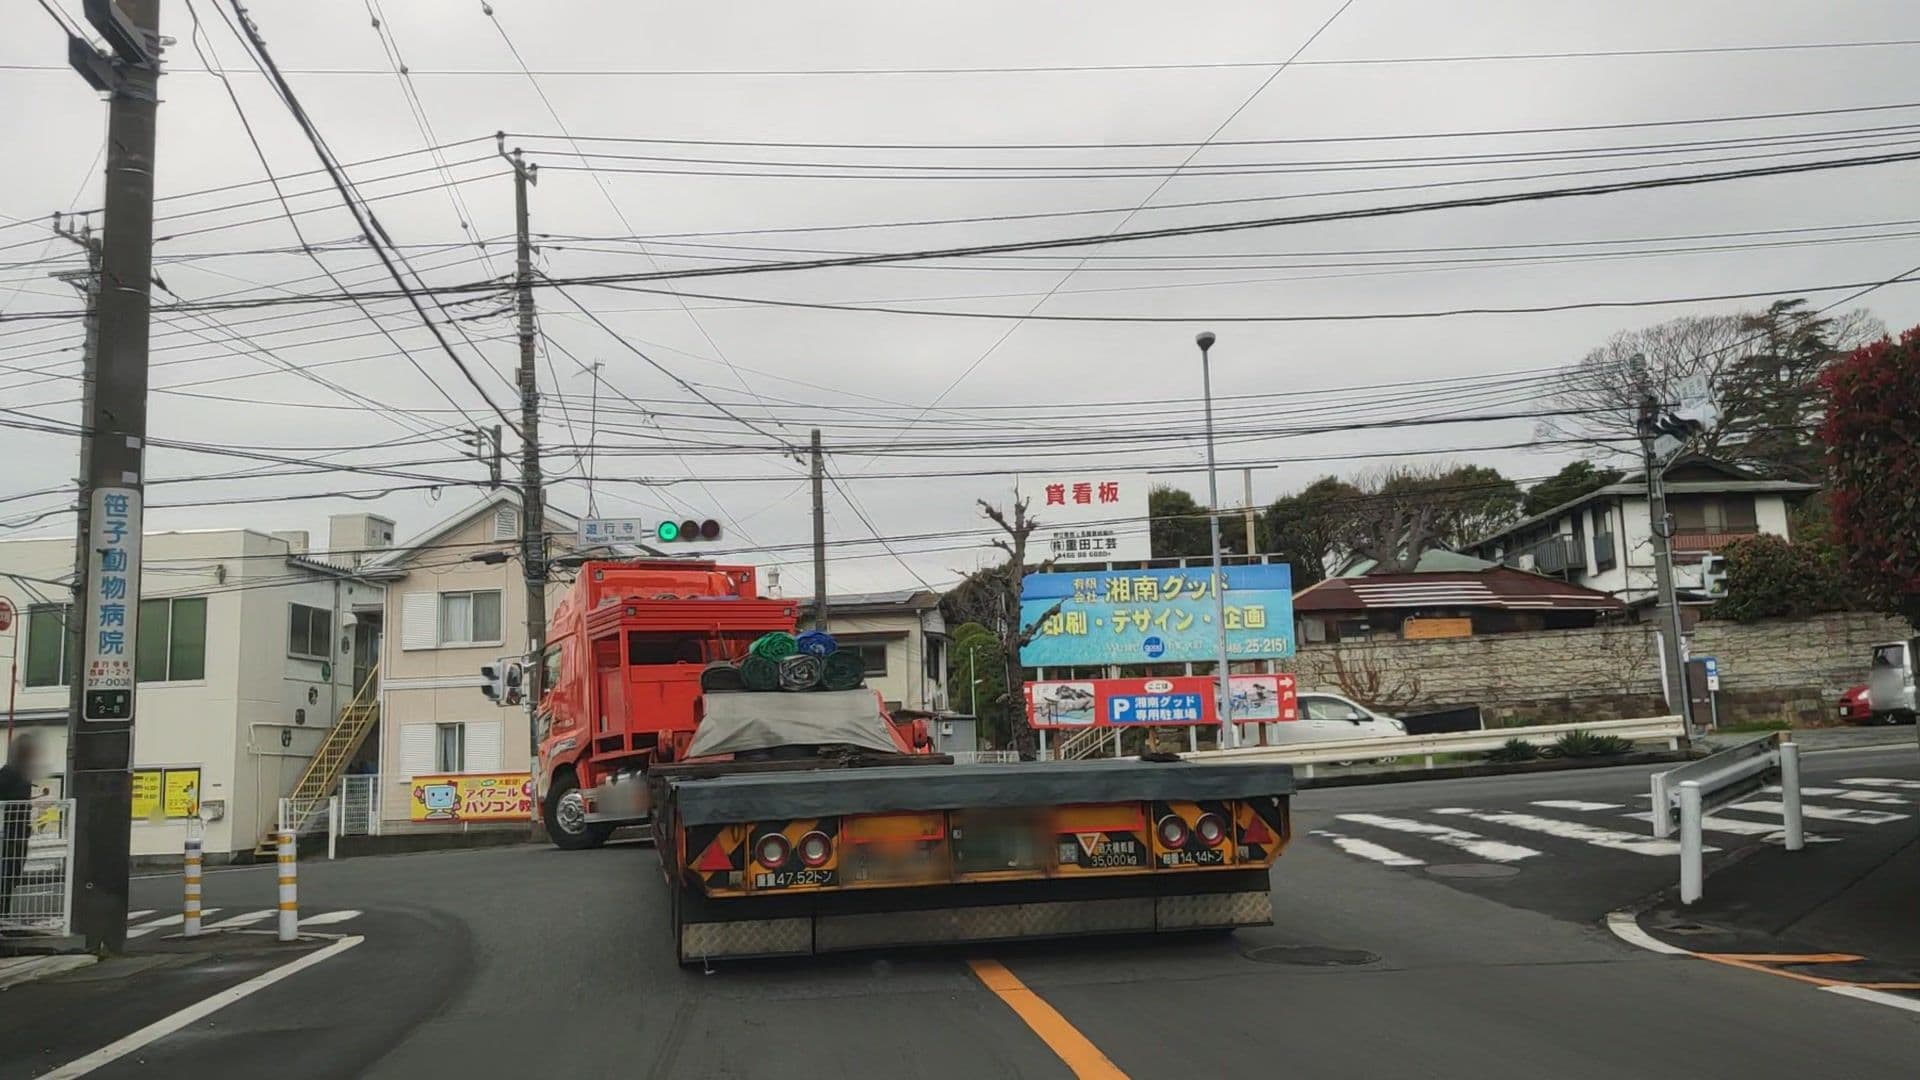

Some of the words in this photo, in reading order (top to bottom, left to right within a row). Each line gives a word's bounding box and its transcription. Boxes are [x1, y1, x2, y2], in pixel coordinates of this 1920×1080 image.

[1045, 482, 1119, 506] 貸看板
[98, 494, 129, 656] 笹子動物病院
[1105, 573, 1229, 602] 湘南グッド
[1113, 698, 1130, 720] P
[1135, 696, 1196, 709] 湘南グッド
[1135, 708, 1197, 721] 専用駐車場
[466, 788, 518, 799] アイアール
